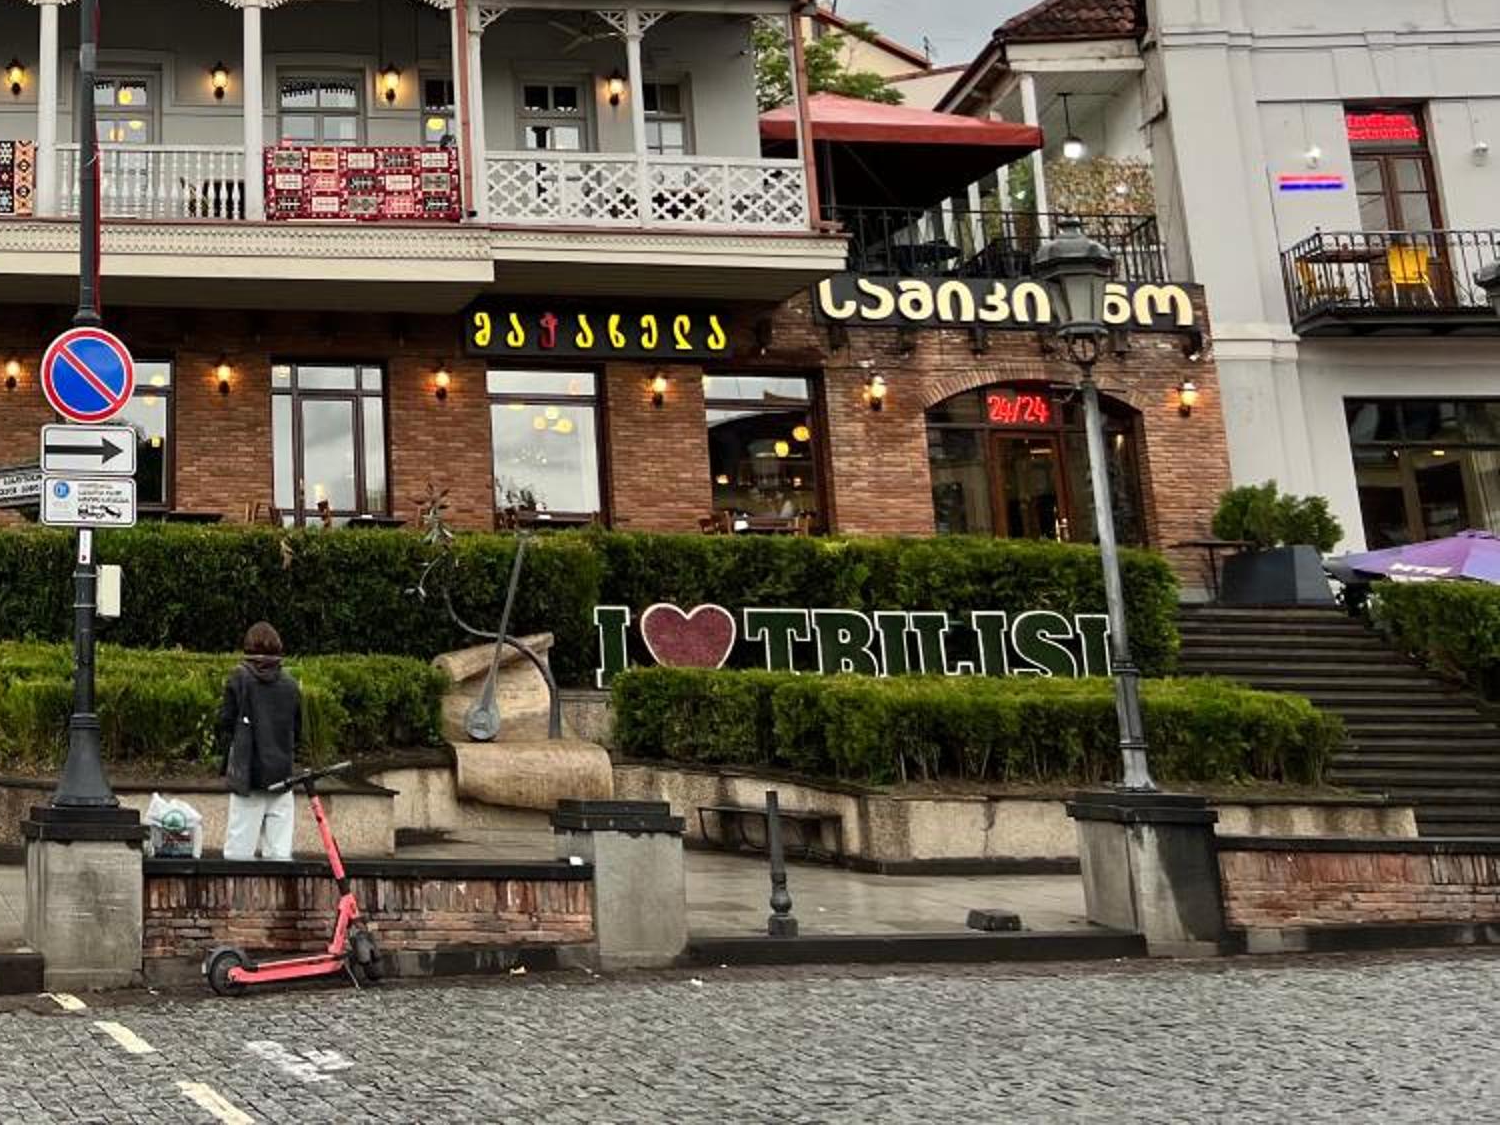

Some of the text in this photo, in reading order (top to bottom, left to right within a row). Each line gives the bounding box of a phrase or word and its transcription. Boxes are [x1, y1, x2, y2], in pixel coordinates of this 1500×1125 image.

[818, 278, 1194, 326] სამიკინო
[987, 395, 1049, 424] 24/24
[594, 606, 1112, 688] I TBILISI
